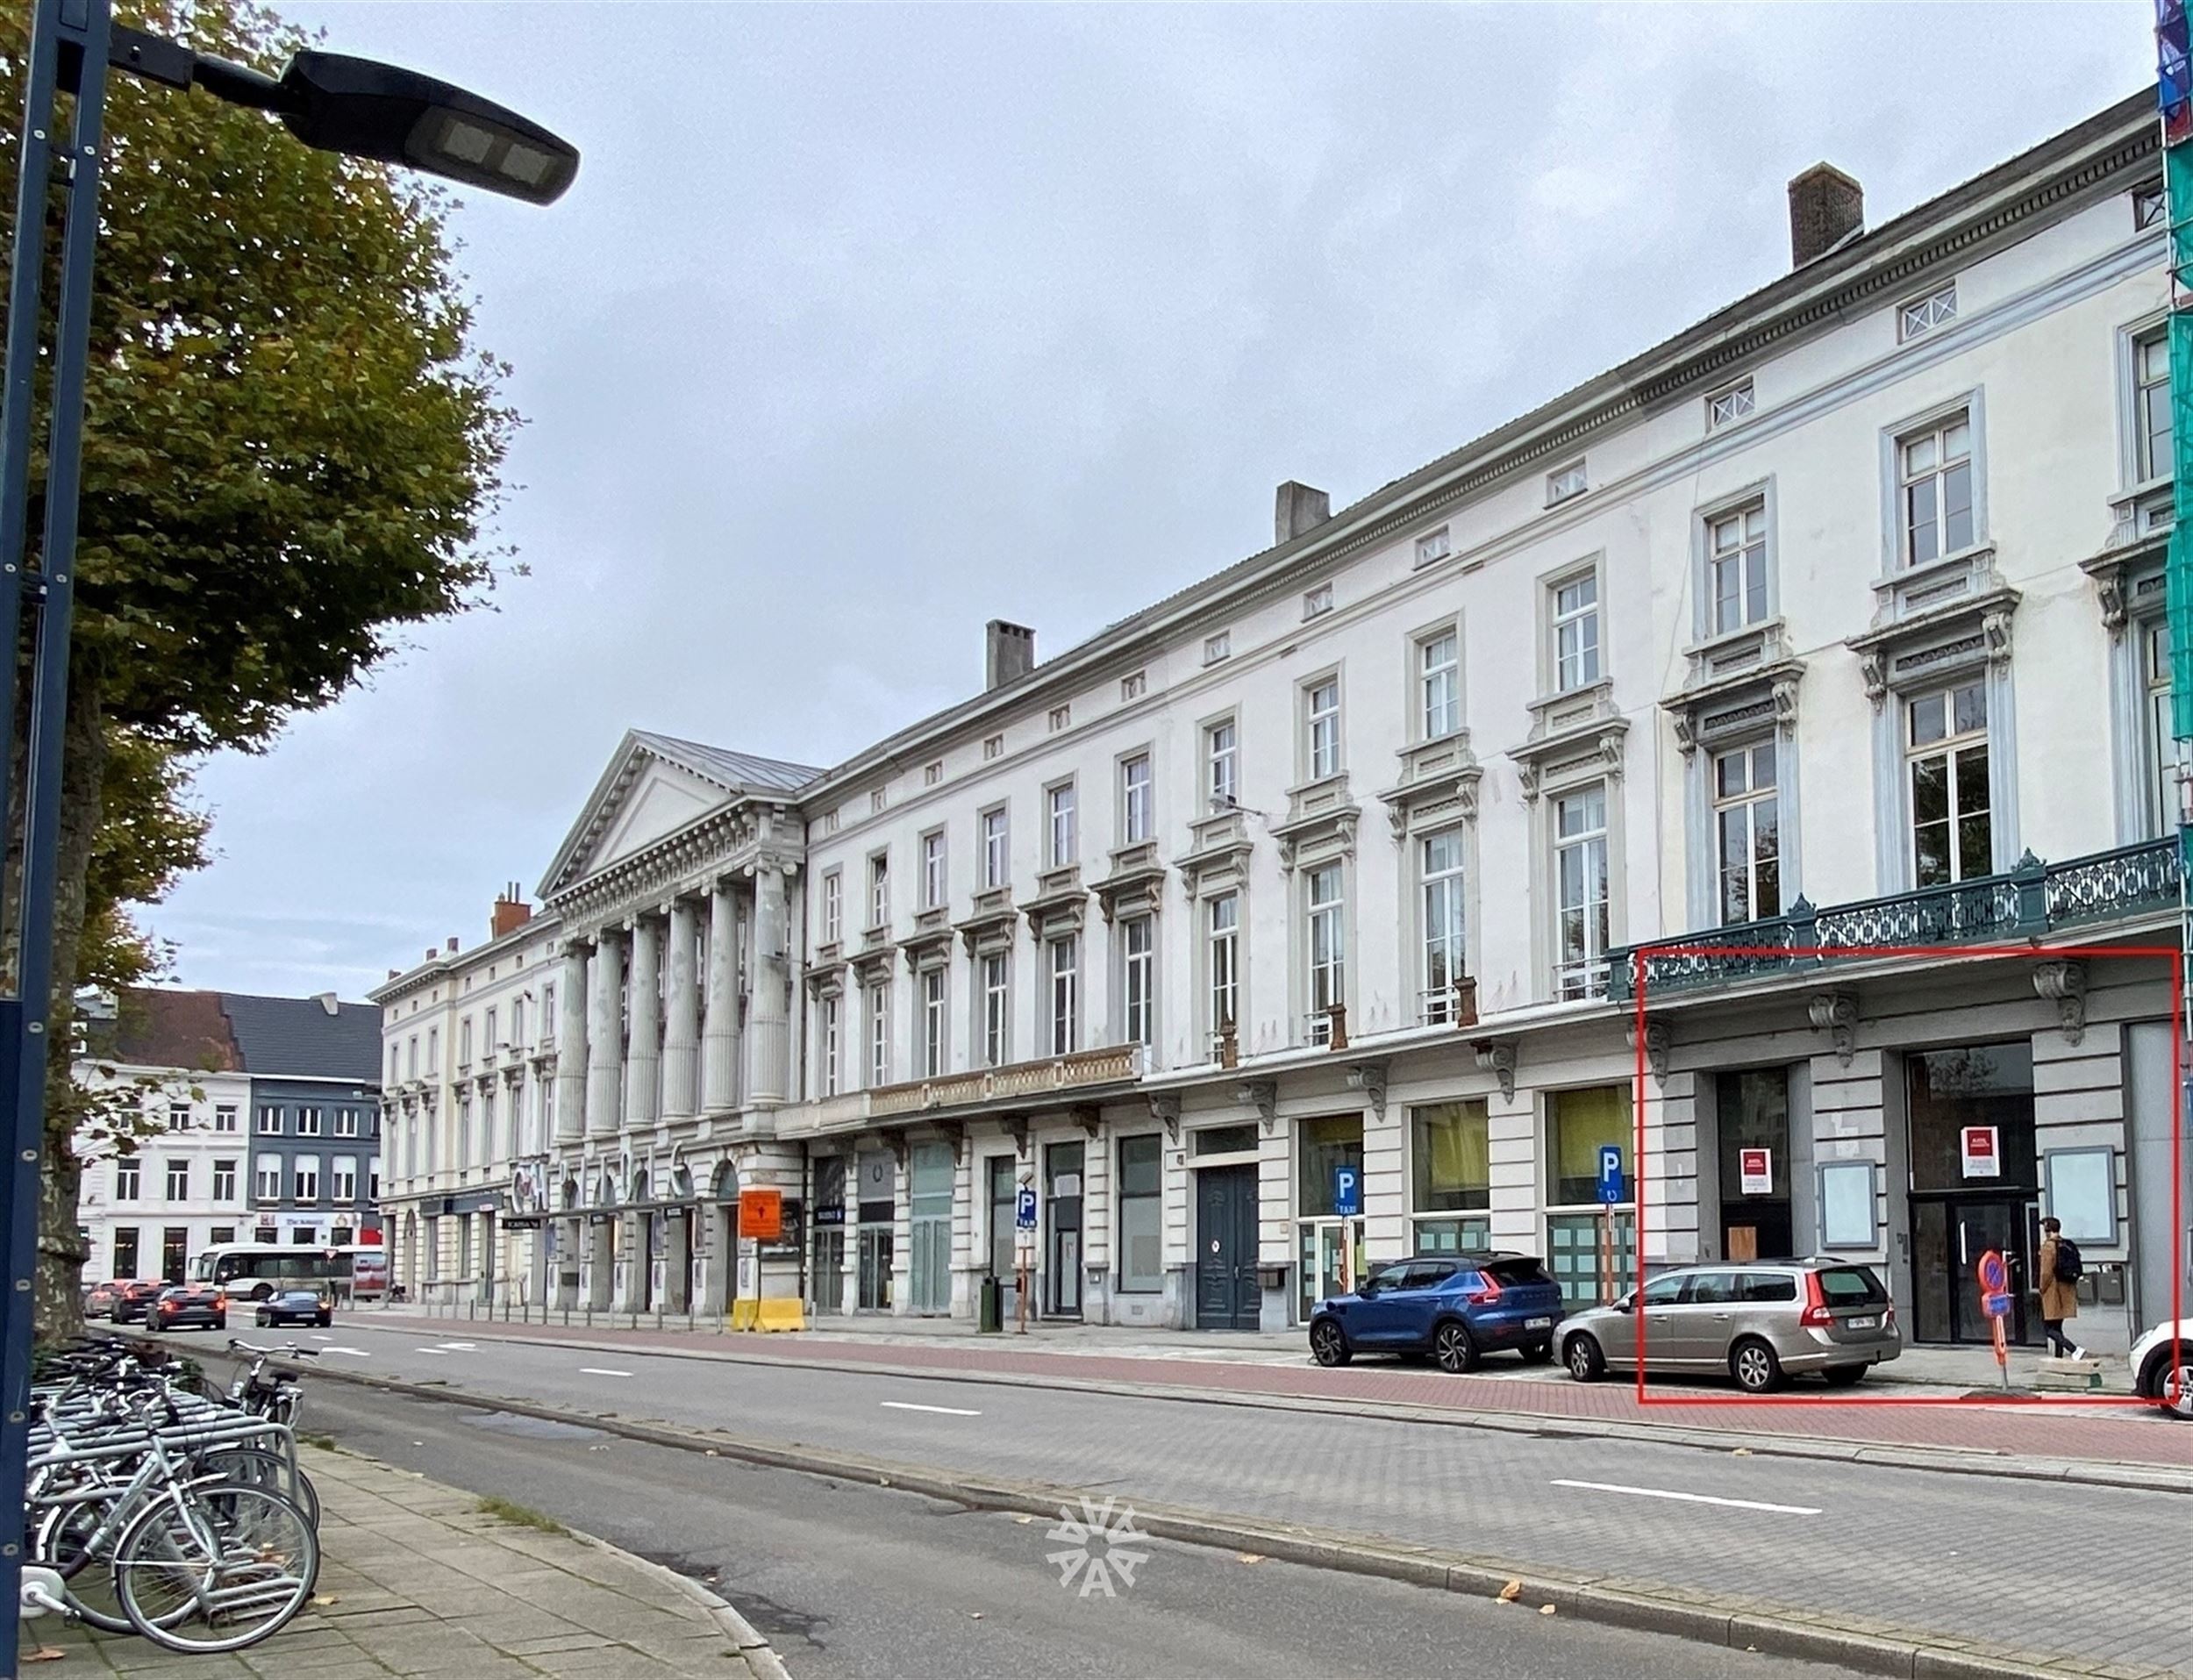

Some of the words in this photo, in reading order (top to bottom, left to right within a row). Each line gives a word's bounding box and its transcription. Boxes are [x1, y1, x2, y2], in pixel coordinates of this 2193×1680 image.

[1603, 1152, 1619, 1183] P
[1339, 1172, 1354, 1199] P
[1020, 1194, 1034, 1214] P
[1339, 1205, 1357, 1214] TAXI
